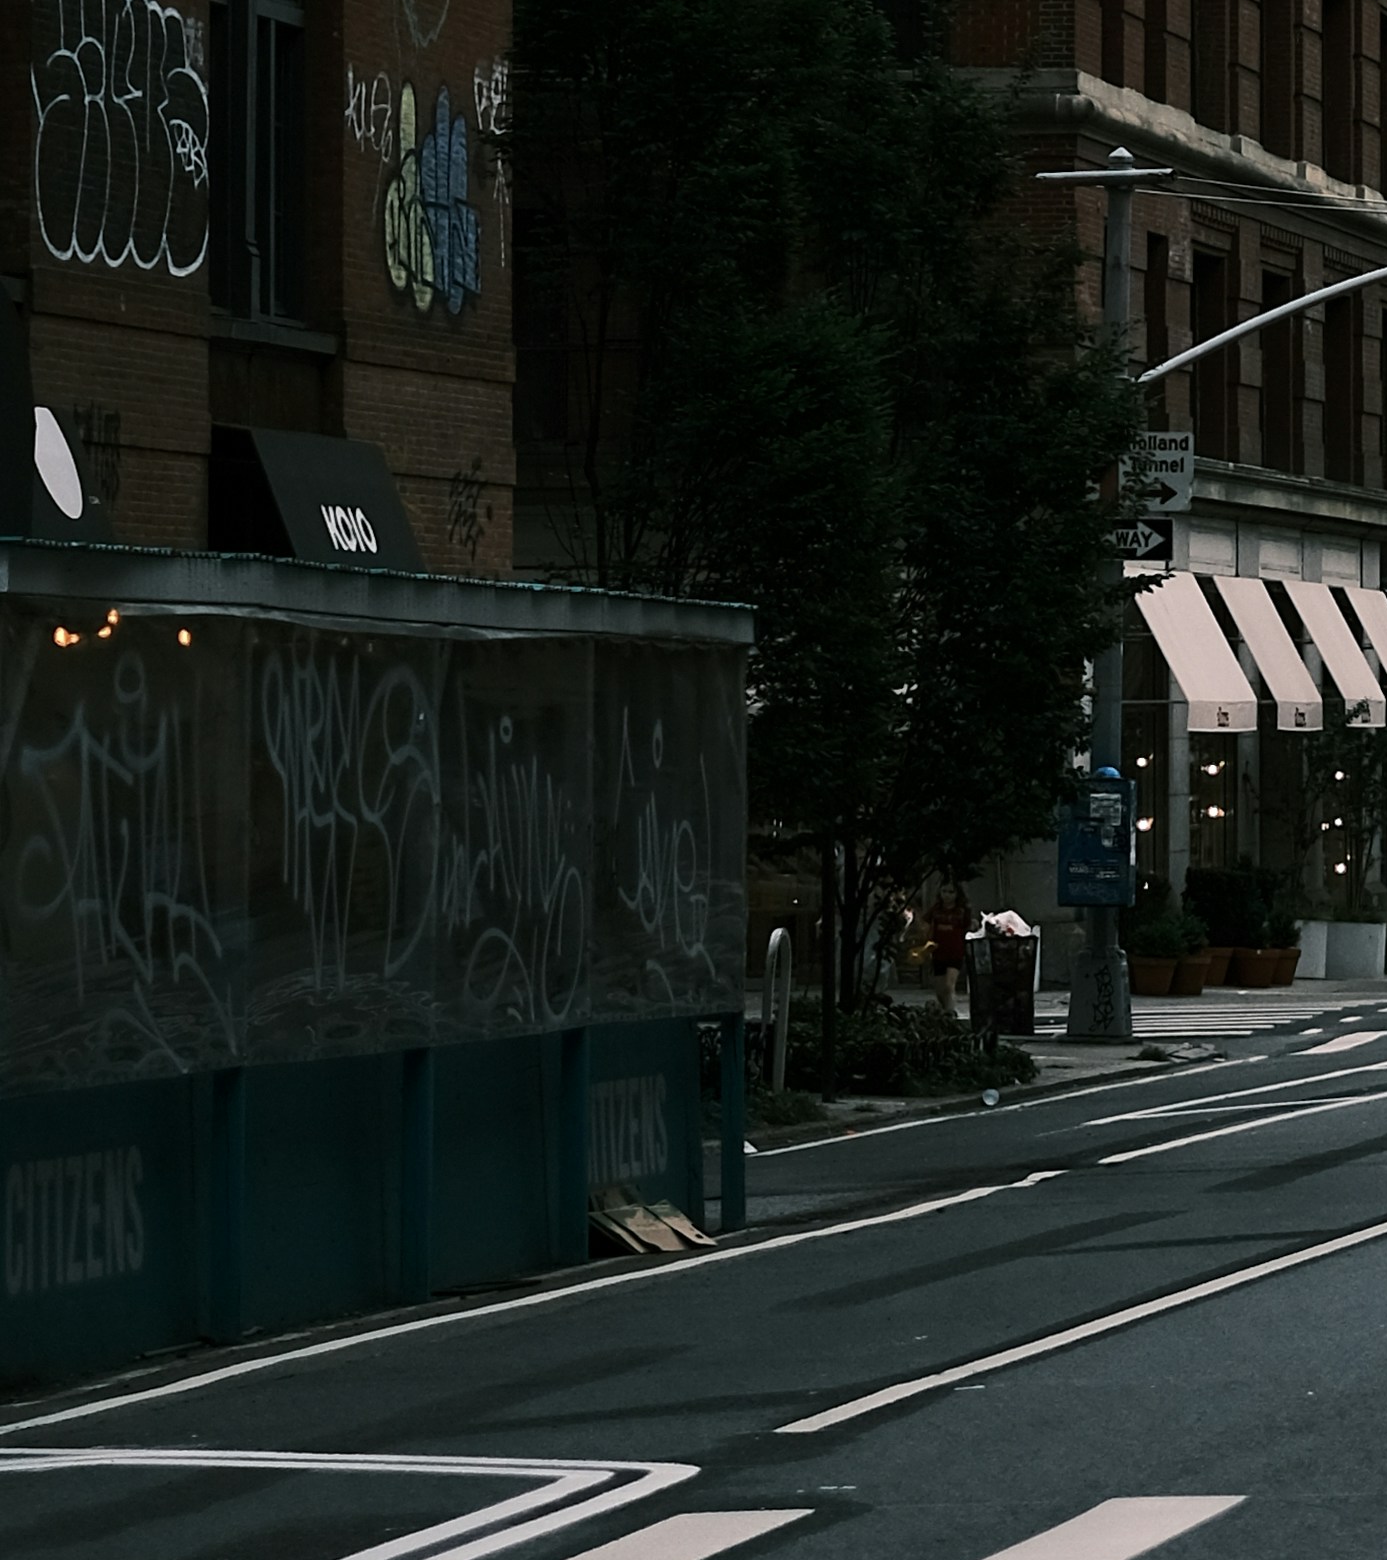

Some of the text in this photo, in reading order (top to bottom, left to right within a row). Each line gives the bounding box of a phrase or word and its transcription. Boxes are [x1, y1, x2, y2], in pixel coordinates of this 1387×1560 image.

[320, 504, 379, 554] KOIO
[1116, 531, 1152, 547] WAY
[6, 1145, 144, 1295] CITIZENS
